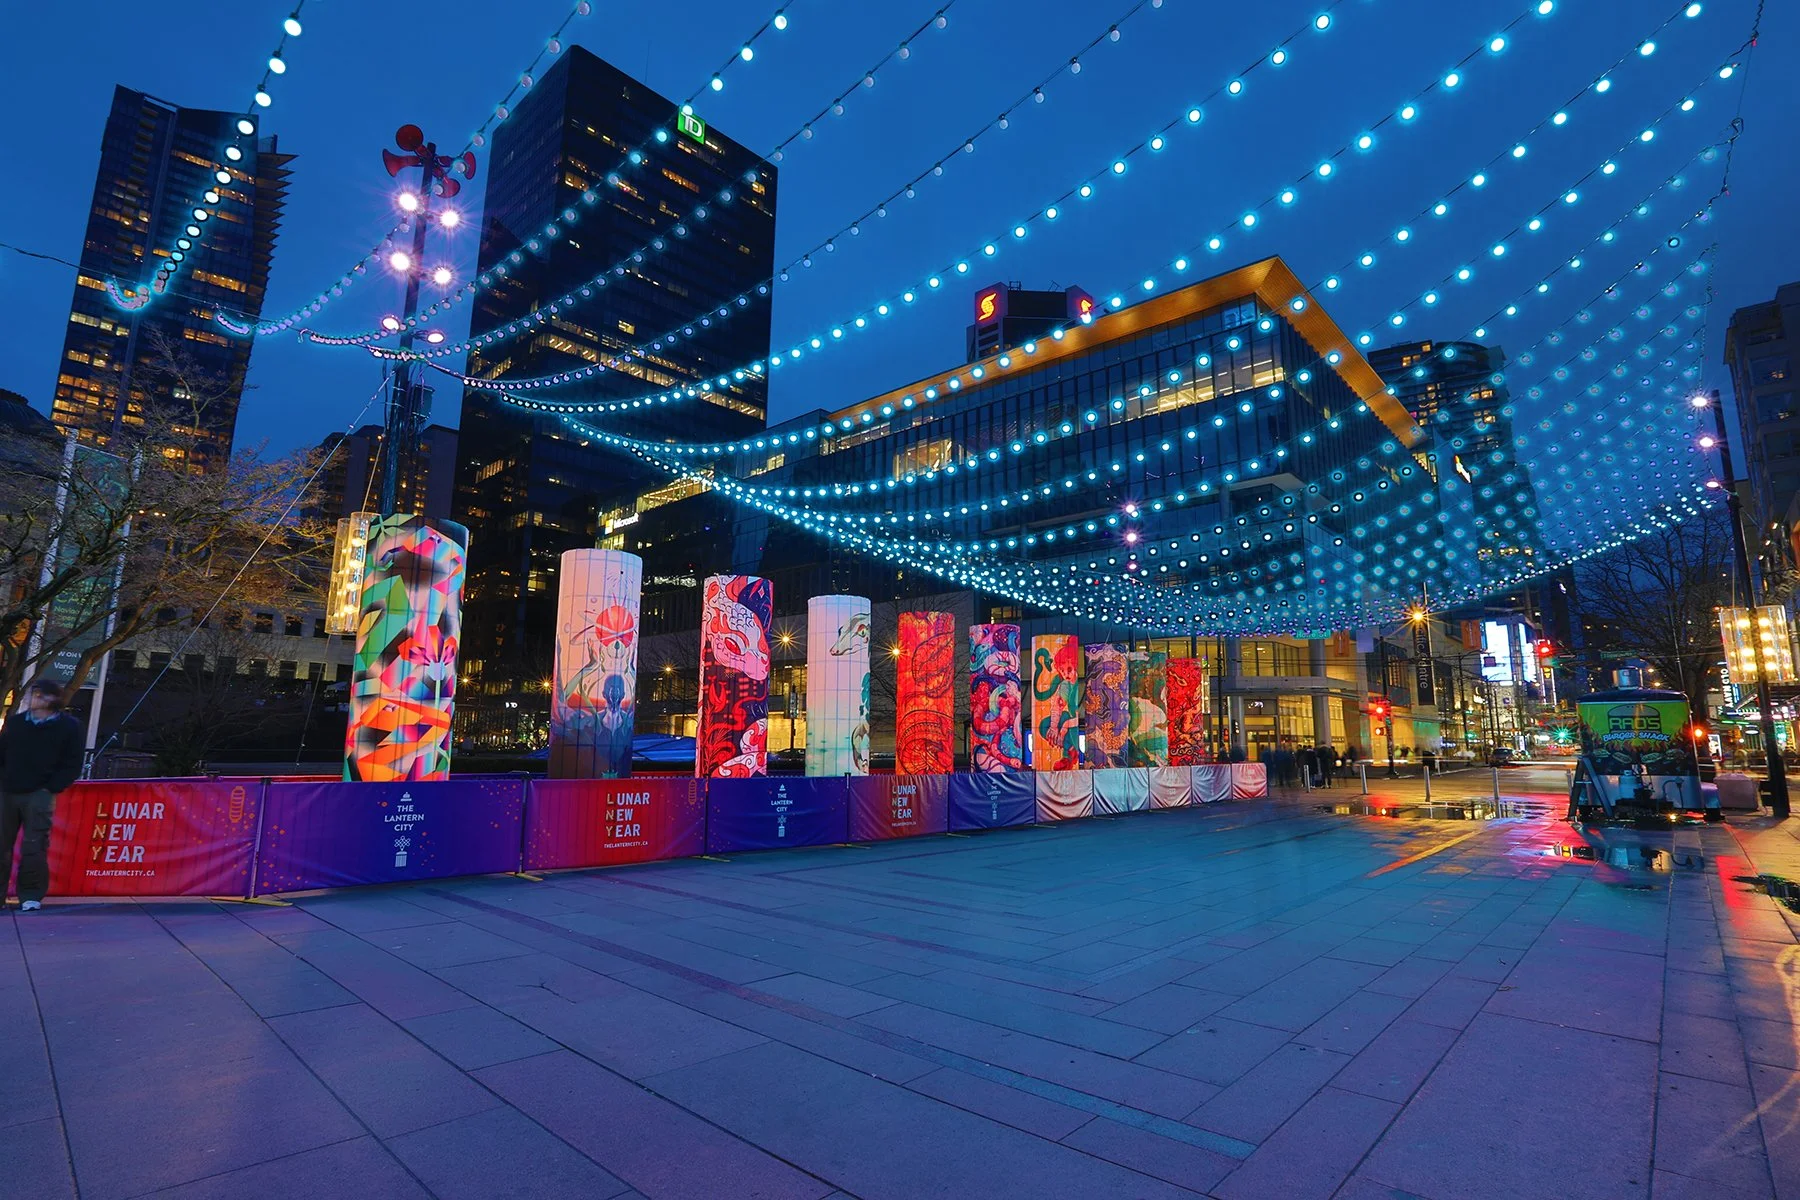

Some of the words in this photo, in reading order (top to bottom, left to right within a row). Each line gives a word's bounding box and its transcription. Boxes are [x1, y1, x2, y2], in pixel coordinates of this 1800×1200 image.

[681, 112, 702, 137] TD
[1720, 668, 1730, 685] OLD
[1722, 685, 1734, 708] NAVY
[1603, 731, 1636, 742] BURGER
[1638, 731, 1670, 742] SHACK
[892, 785, 917, 795] LUNAR
[606, 792, 650, 805] LUNAR
[97, 802, 165, 819] LUNAR
[397, 804, 414, 812] THE
[605, 808, 634, 822] NEW
[892, 809, 912, 819] YEAR
[384, 813, 425, 823] LANTERN
[92, 824, 137, 841] NEW
[394, 823, 414, 831] CITY
[605, 823, 641, 838] YEAR
[92, 845, 145, 863] YEAR
